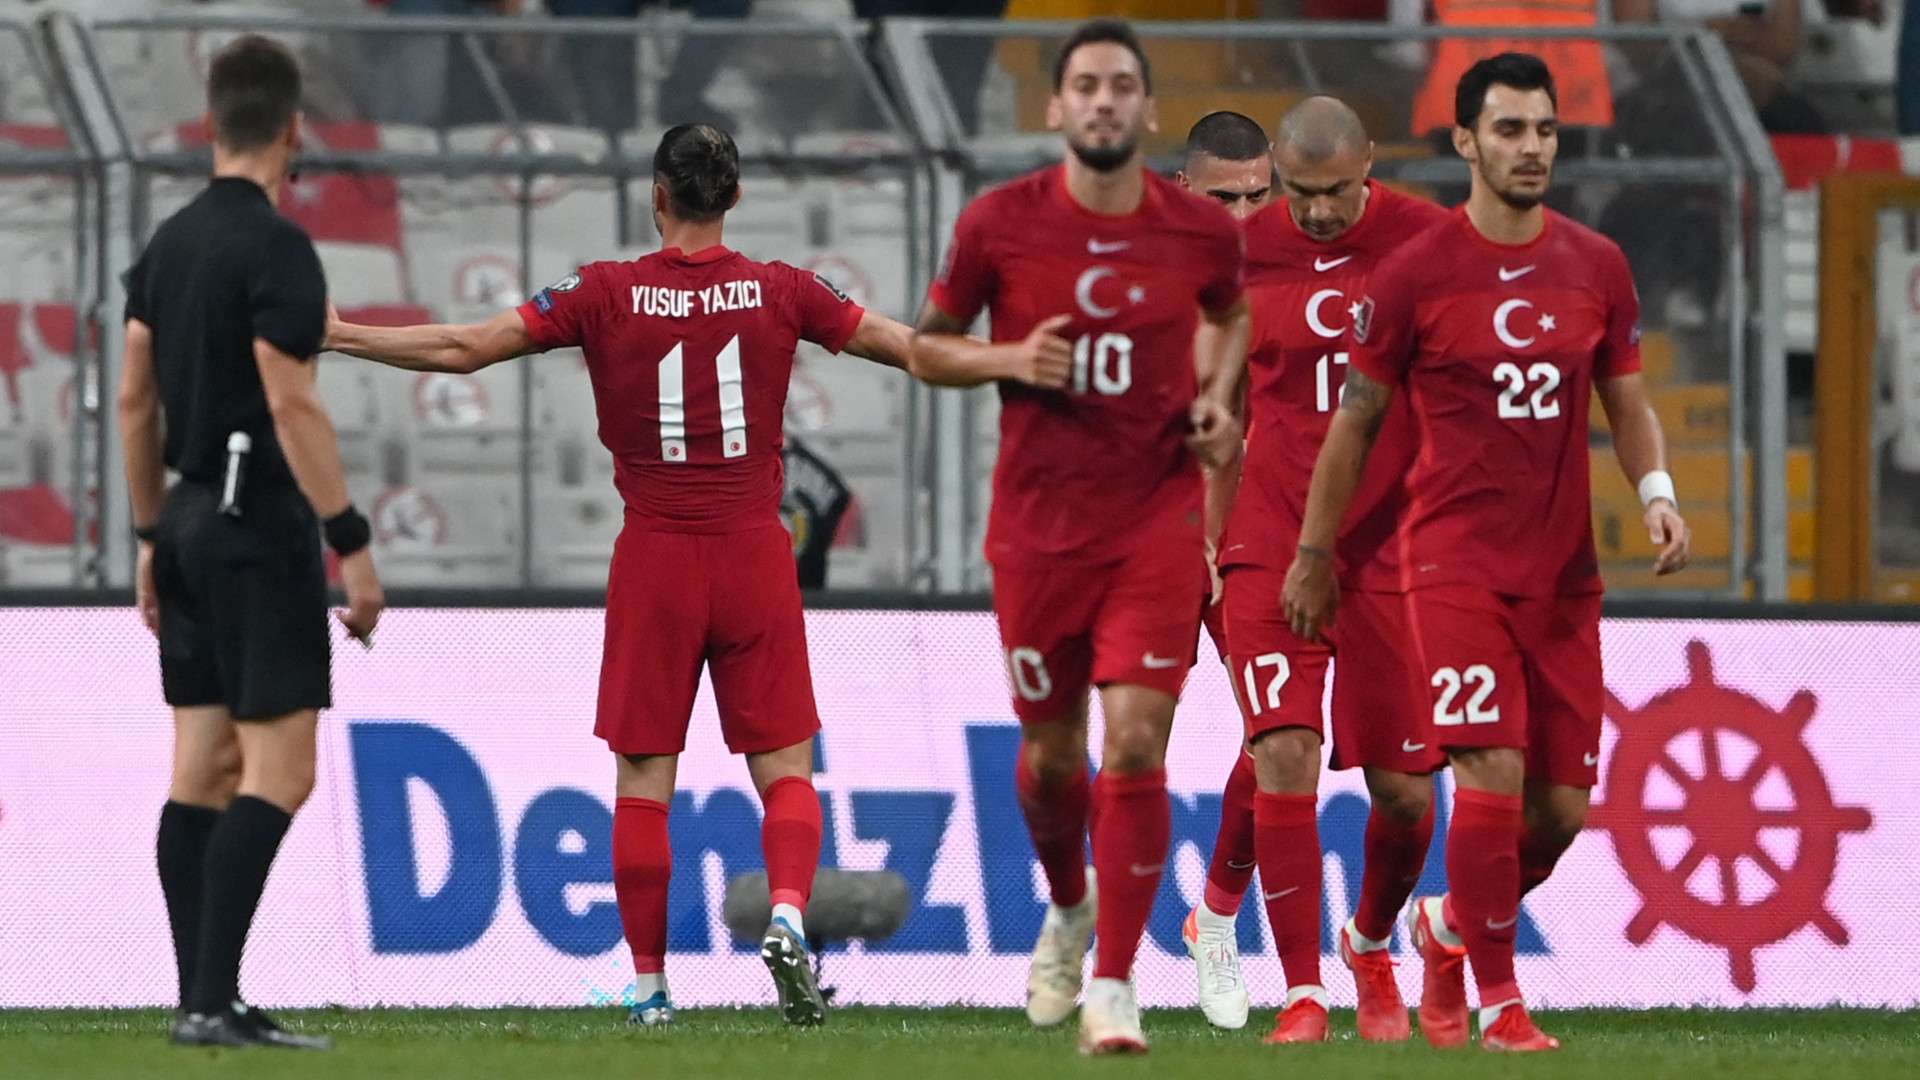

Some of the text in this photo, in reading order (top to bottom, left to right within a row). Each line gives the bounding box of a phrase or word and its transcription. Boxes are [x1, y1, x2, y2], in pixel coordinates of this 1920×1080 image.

[631, 280, 762, 317] YUSUF YAZICI
[1073, 332, 1133, 396] 10
[1492, 362, 1560, 420] 22
[658, 333, 748, 462] 11
[1005, 646, 1052, 702] 0
[1243, 652, 1290, 716] 17
[1431, 664, 1499, 726] 22
[348, 720, 1554, 956] Denzan
